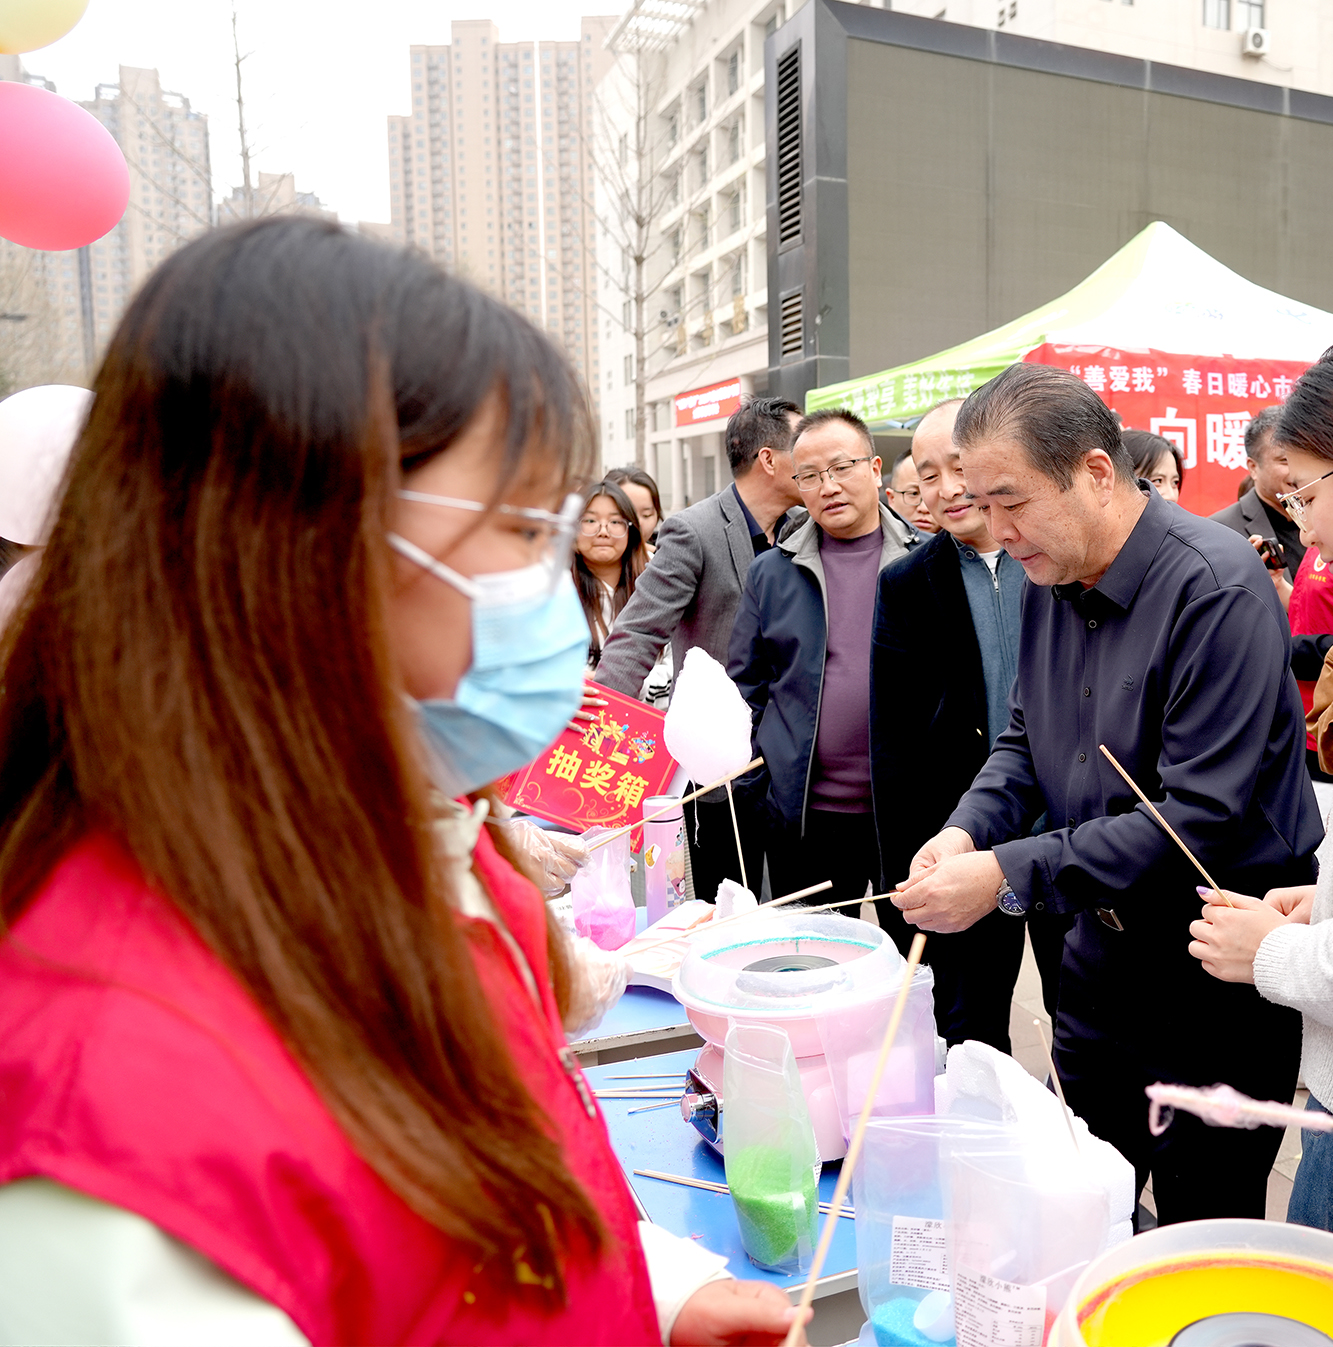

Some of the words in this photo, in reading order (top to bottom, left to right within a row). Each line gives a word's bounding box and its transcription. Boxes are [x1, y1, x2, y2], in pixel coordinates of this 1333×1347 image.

[1182, 368, 1302, 399] 春日暖心市
[545, 744, 650, 809] 抽奖箱
